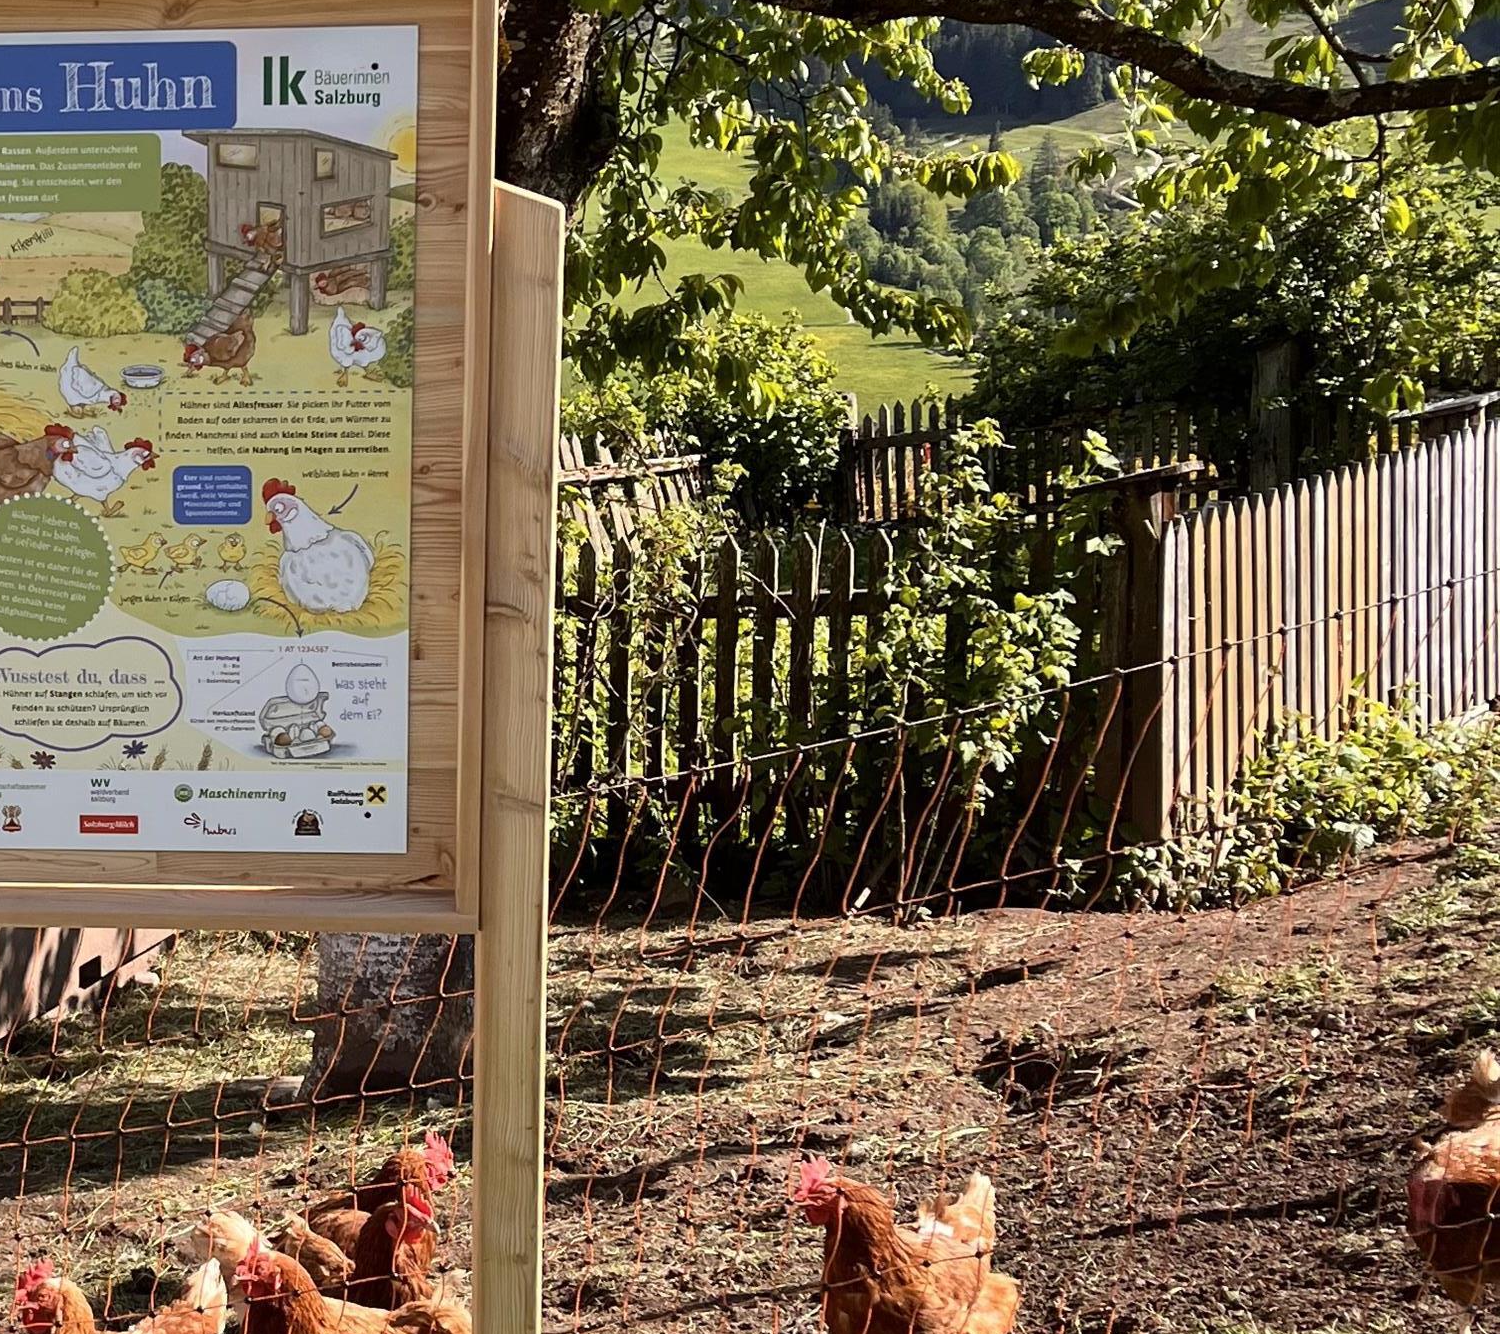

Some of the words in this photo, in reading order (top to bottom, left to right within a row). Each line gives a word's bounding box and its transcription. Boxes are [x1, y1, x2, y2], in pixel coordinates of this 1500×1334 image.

[314, 69, 390, 85] Bäuerinnen
[58, 61, 216, 113] Huhn
[314, 89, 380, 107] Salzburg
[81, 145, 138, 154] unterscheidet
[240, 431, 257, 439] sind
[260, 431, 279, 439] auch
[367, 430, 391, 438] Diese
[76, 668, 102, 685] du,
[109, 668, 147, 685] dass
[358, 677, 388, 689] steht
[3, 690, 32, 698] Hühner
[34, 690, 48, 699] auf
[50, 690, 83, 699] Stangen
[136, 690, 152, 698] sich
[352, 692, 370, 705] auf
[12, 704, 44, 712] Feinden
[57, 704, 96, 712] schützen?
[99, 704, 149, 713] Ursprünglich
[339, 709, 363, 720] dem
[367, 709, 382, 720] Ei?
[14, 719, 50, 727] schliefen
[98, 719, 110, 727] auf
[198, 788, 287, 802] Maschinenring
